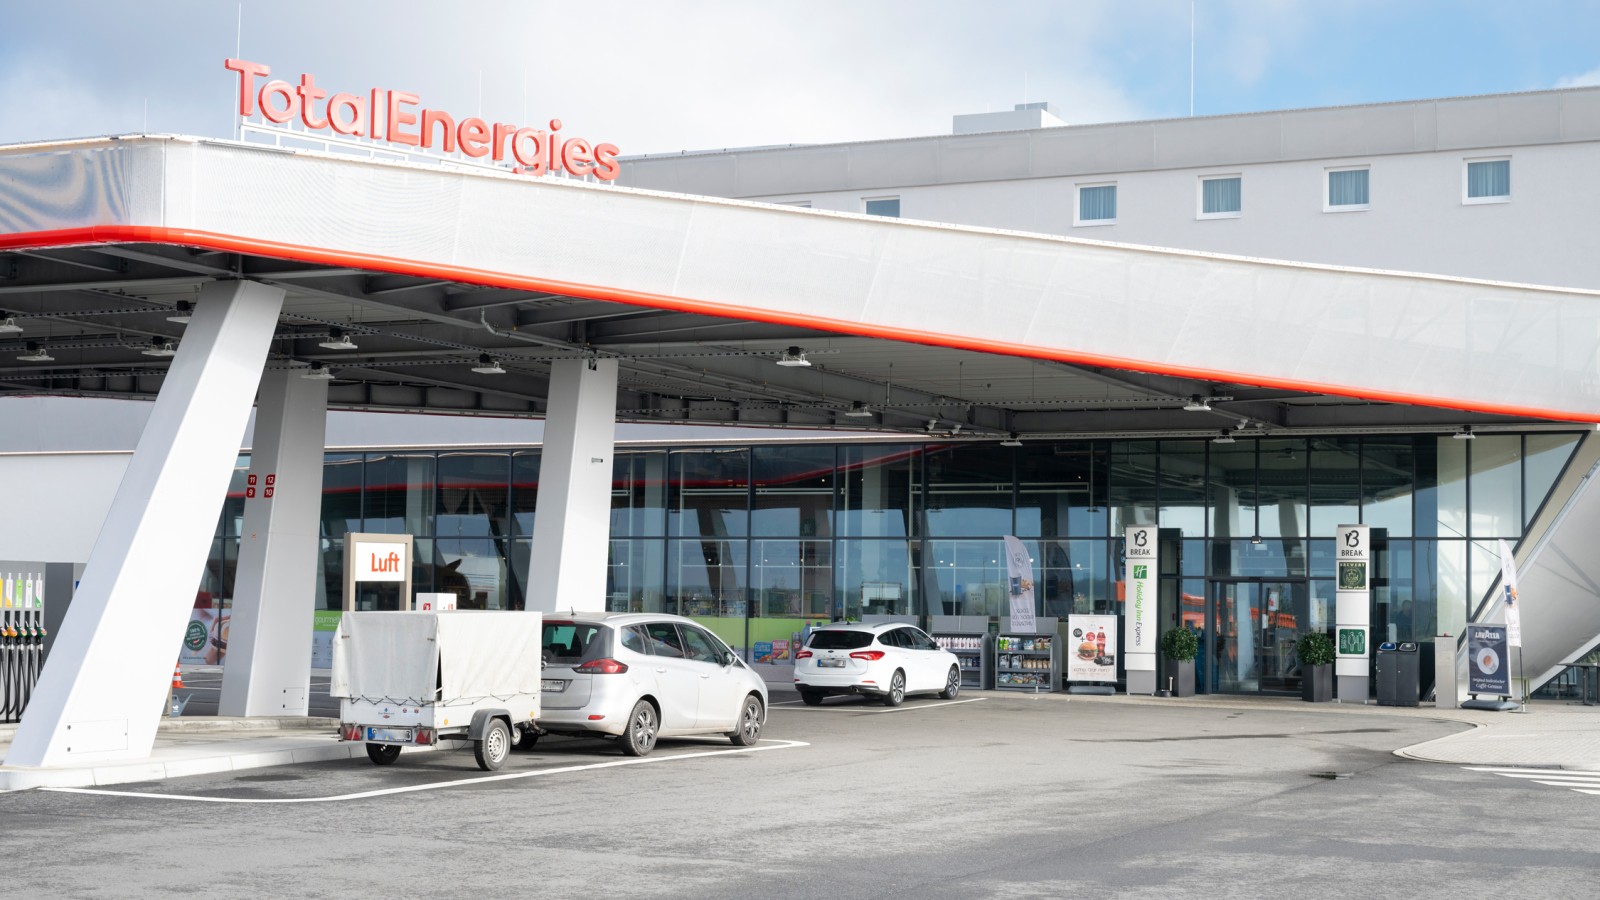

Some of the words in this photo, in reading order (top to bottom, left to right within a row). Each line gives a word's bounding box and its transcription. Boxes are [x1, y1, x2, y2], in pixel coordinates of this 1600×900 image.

[225, 58, 620, 181] TotalEnergies
[371, 552, 400, 572] Luft
[1135, 581, 1144, 610] Holiday
[1135, 622, 1143, 646] Express
[1475, 630, 1500, 639] LAVAZZA
